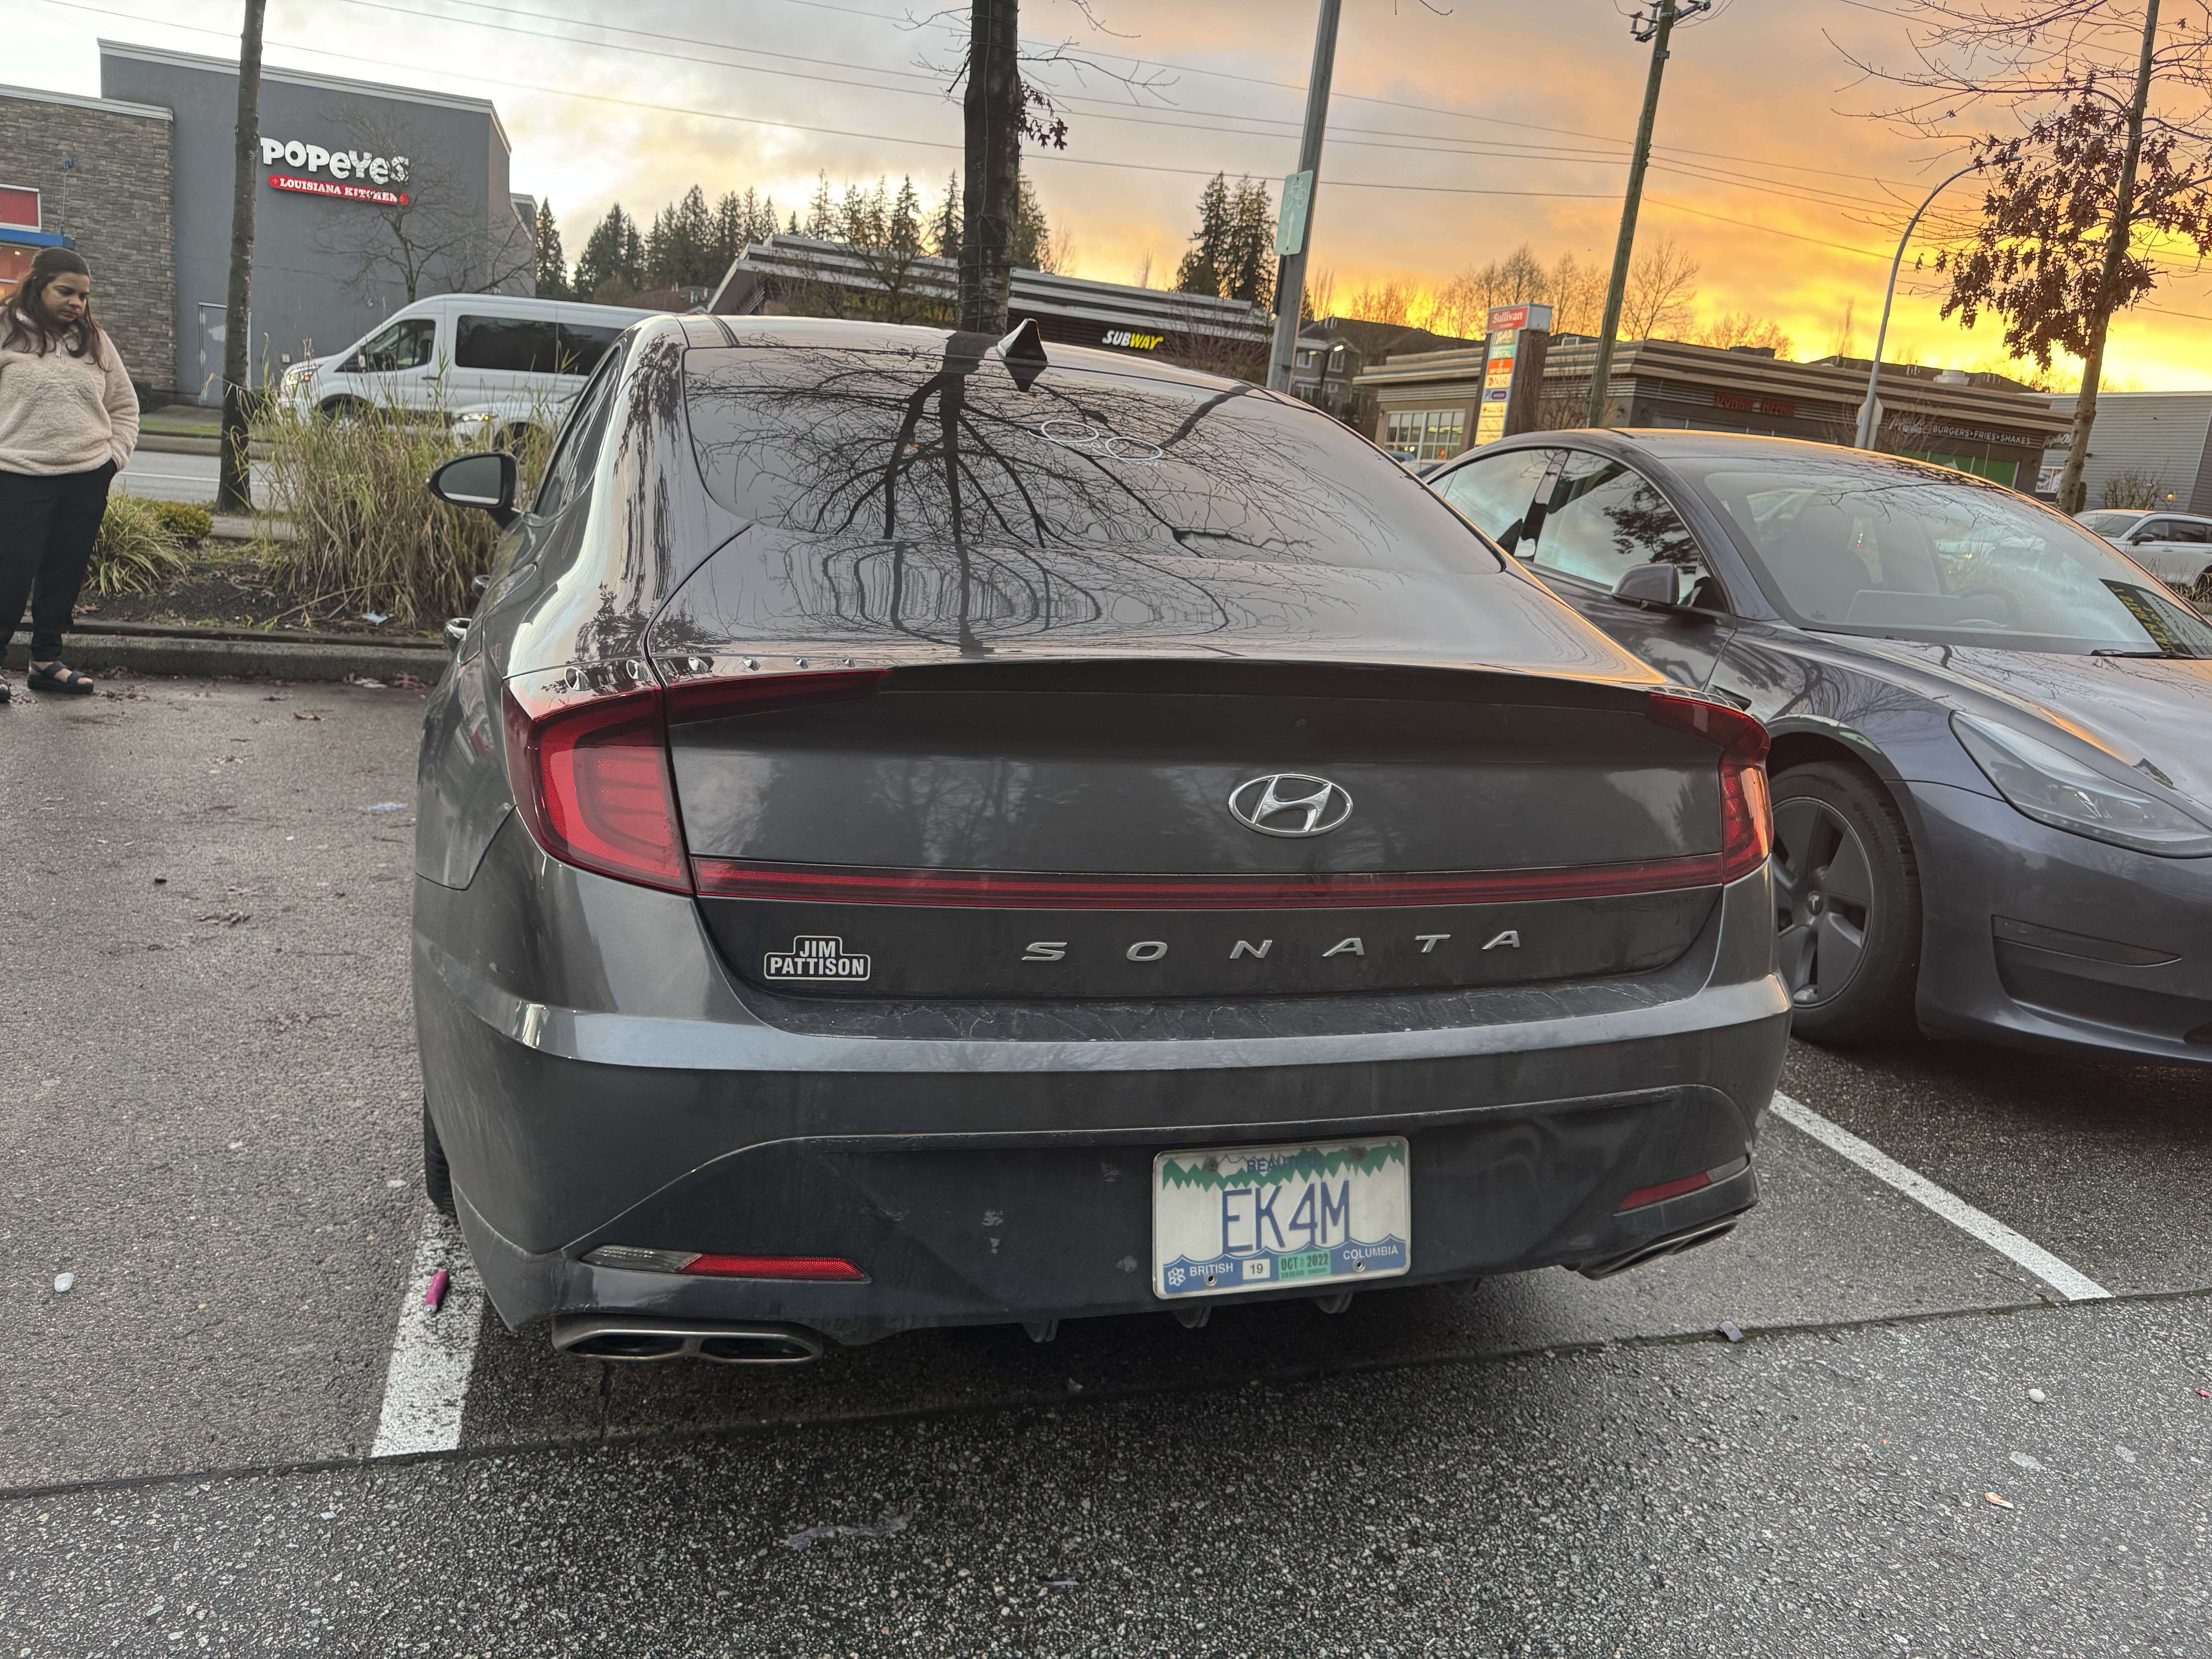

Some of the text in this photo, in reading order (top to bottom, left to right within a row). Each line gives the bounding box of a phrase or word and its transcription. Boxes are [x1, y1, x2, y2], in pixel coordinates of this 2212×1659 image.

[280, 177, 398, 203] LOUISIANA KITCHEN
[1492, 311, 1523, 324] Sullivan
[1102, 330, 1164, 350] SUBWAY
[1932, 424, 1970, 437] BURGERS
[1973, 430, 1996, 441] FRIES
[2000, 433, 2031, 445] SHAKES
[799, 940, 836, 958] JIM
[1021, 930, 1521, 961] SONATA
[770, 957, 864, 975] PATTISON
[1222, 1180, 1350, 1254] EK4M
[1343, 1245, 1399, 1260] COLUMBIA
[1189, 1262, 1233, 1277] BRITISH
[1250, 1263, 1264, 1274] 19
[1281, 1253, 1329, 1271] OCT 2022
